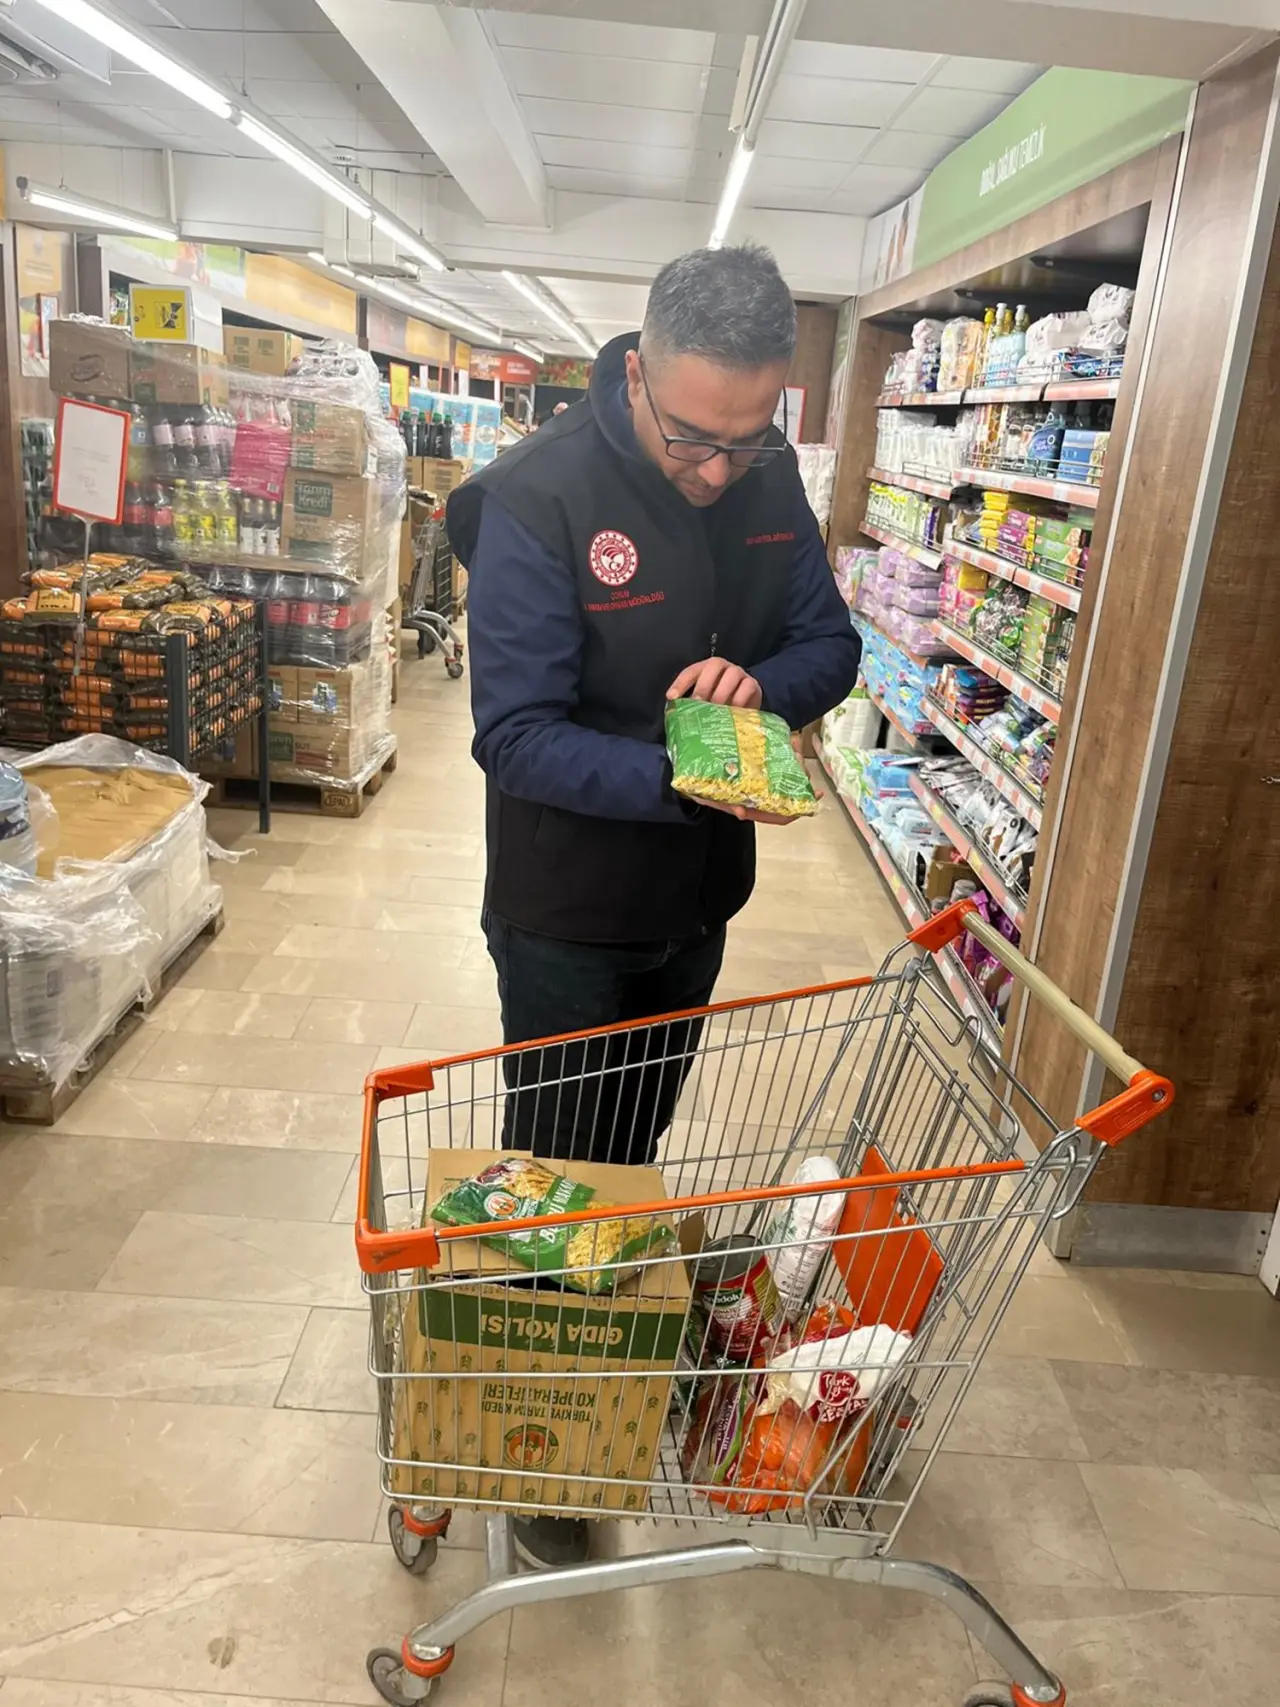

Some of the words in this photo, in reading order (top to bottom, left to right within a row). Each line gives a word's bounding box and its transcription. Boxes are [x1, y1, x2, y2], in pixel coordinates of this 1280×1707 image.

[480, 1314, 558, 1341] KOLİSİ
[566, 1323, 623, 1346] GIDA
[551, 1407, 592, 1423] TÜRKİYE
